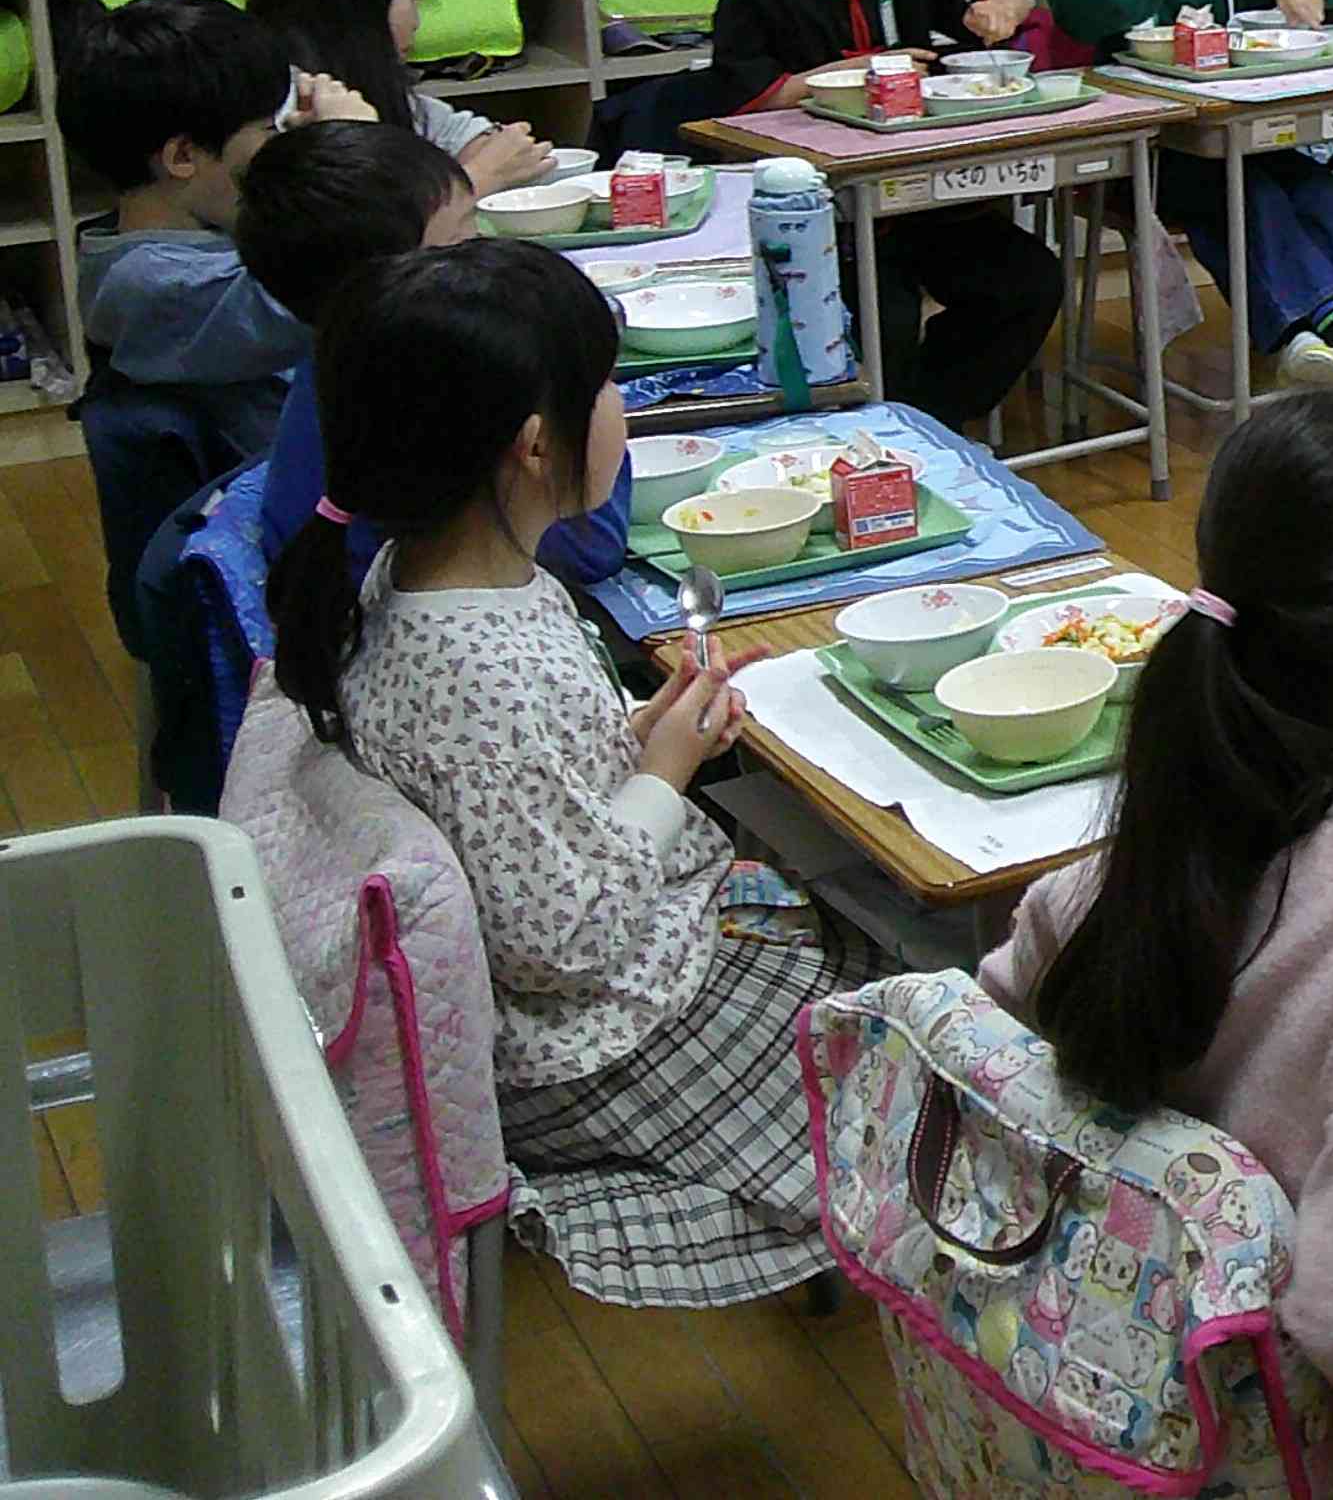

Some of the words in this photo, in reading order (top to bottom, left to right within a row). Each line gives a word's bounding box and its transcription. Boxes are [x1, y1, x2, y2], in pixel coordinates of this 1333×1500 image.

[943, 165, 986, 189] くさの
[997, 159, 1046, 184] いちか
